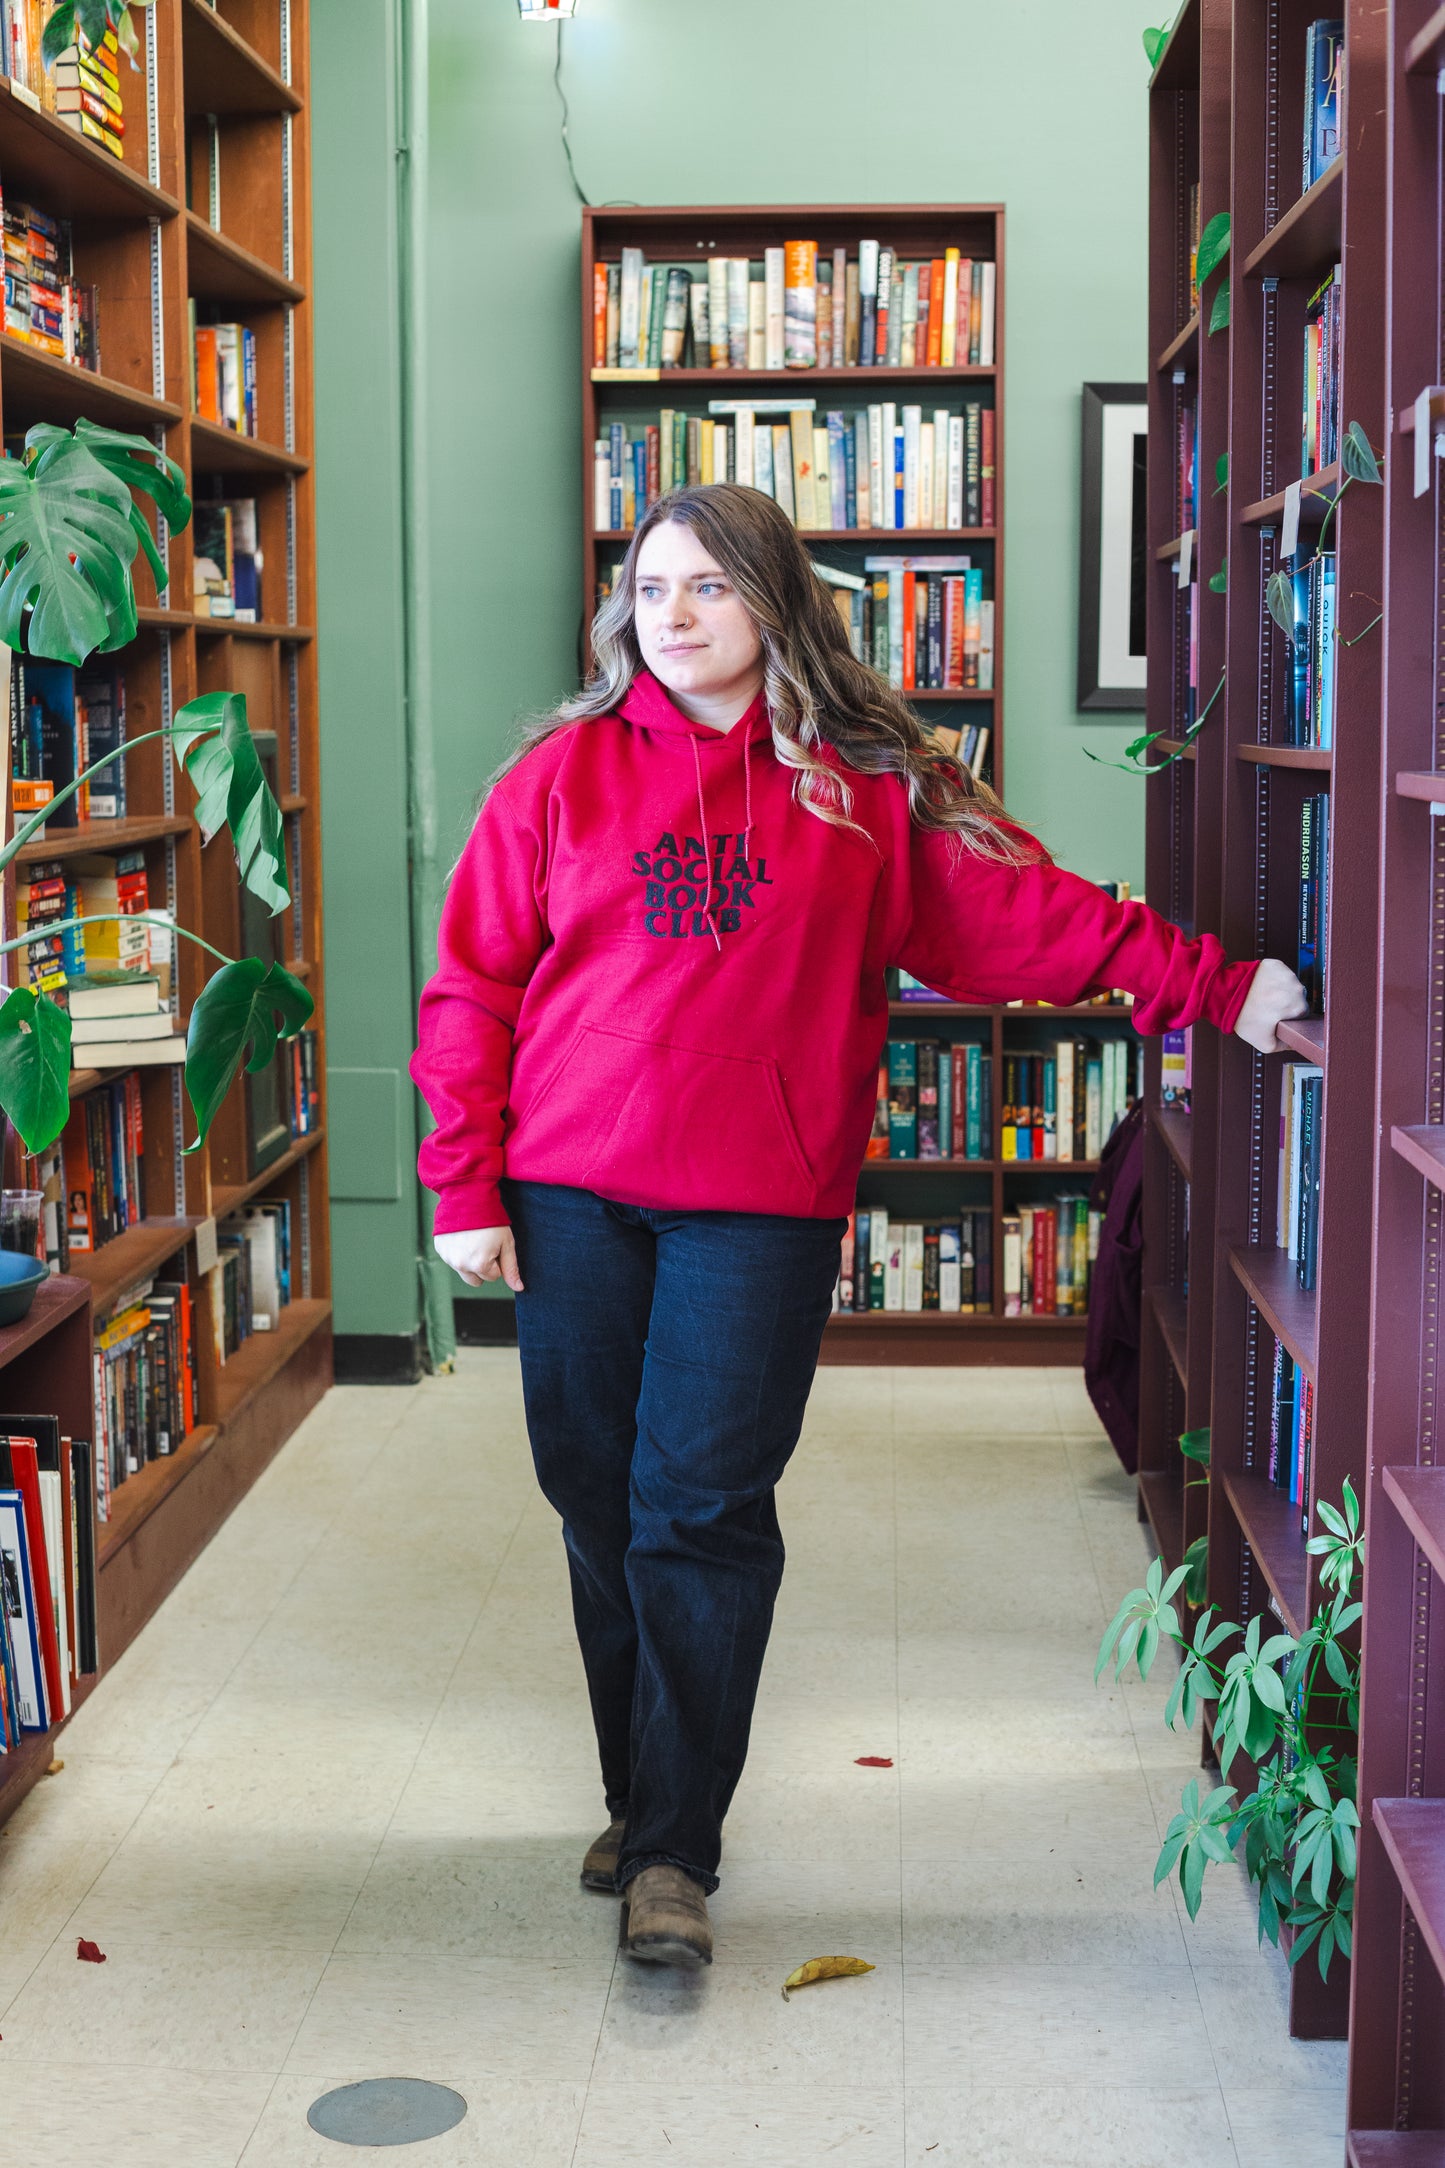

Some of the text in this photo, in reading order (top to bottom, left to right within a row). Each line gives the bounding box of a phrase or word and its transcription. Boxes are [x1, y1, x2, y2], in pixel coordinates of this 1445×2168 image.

[653, 831, 747, 859] ANTI
[1301, 807, 1310, 880] INDRIDASON
[631, 851, 774, 885] SOCIAL
[643, 880, 757, 912] BOOK
[643, 908, 742, 939] CLUB
